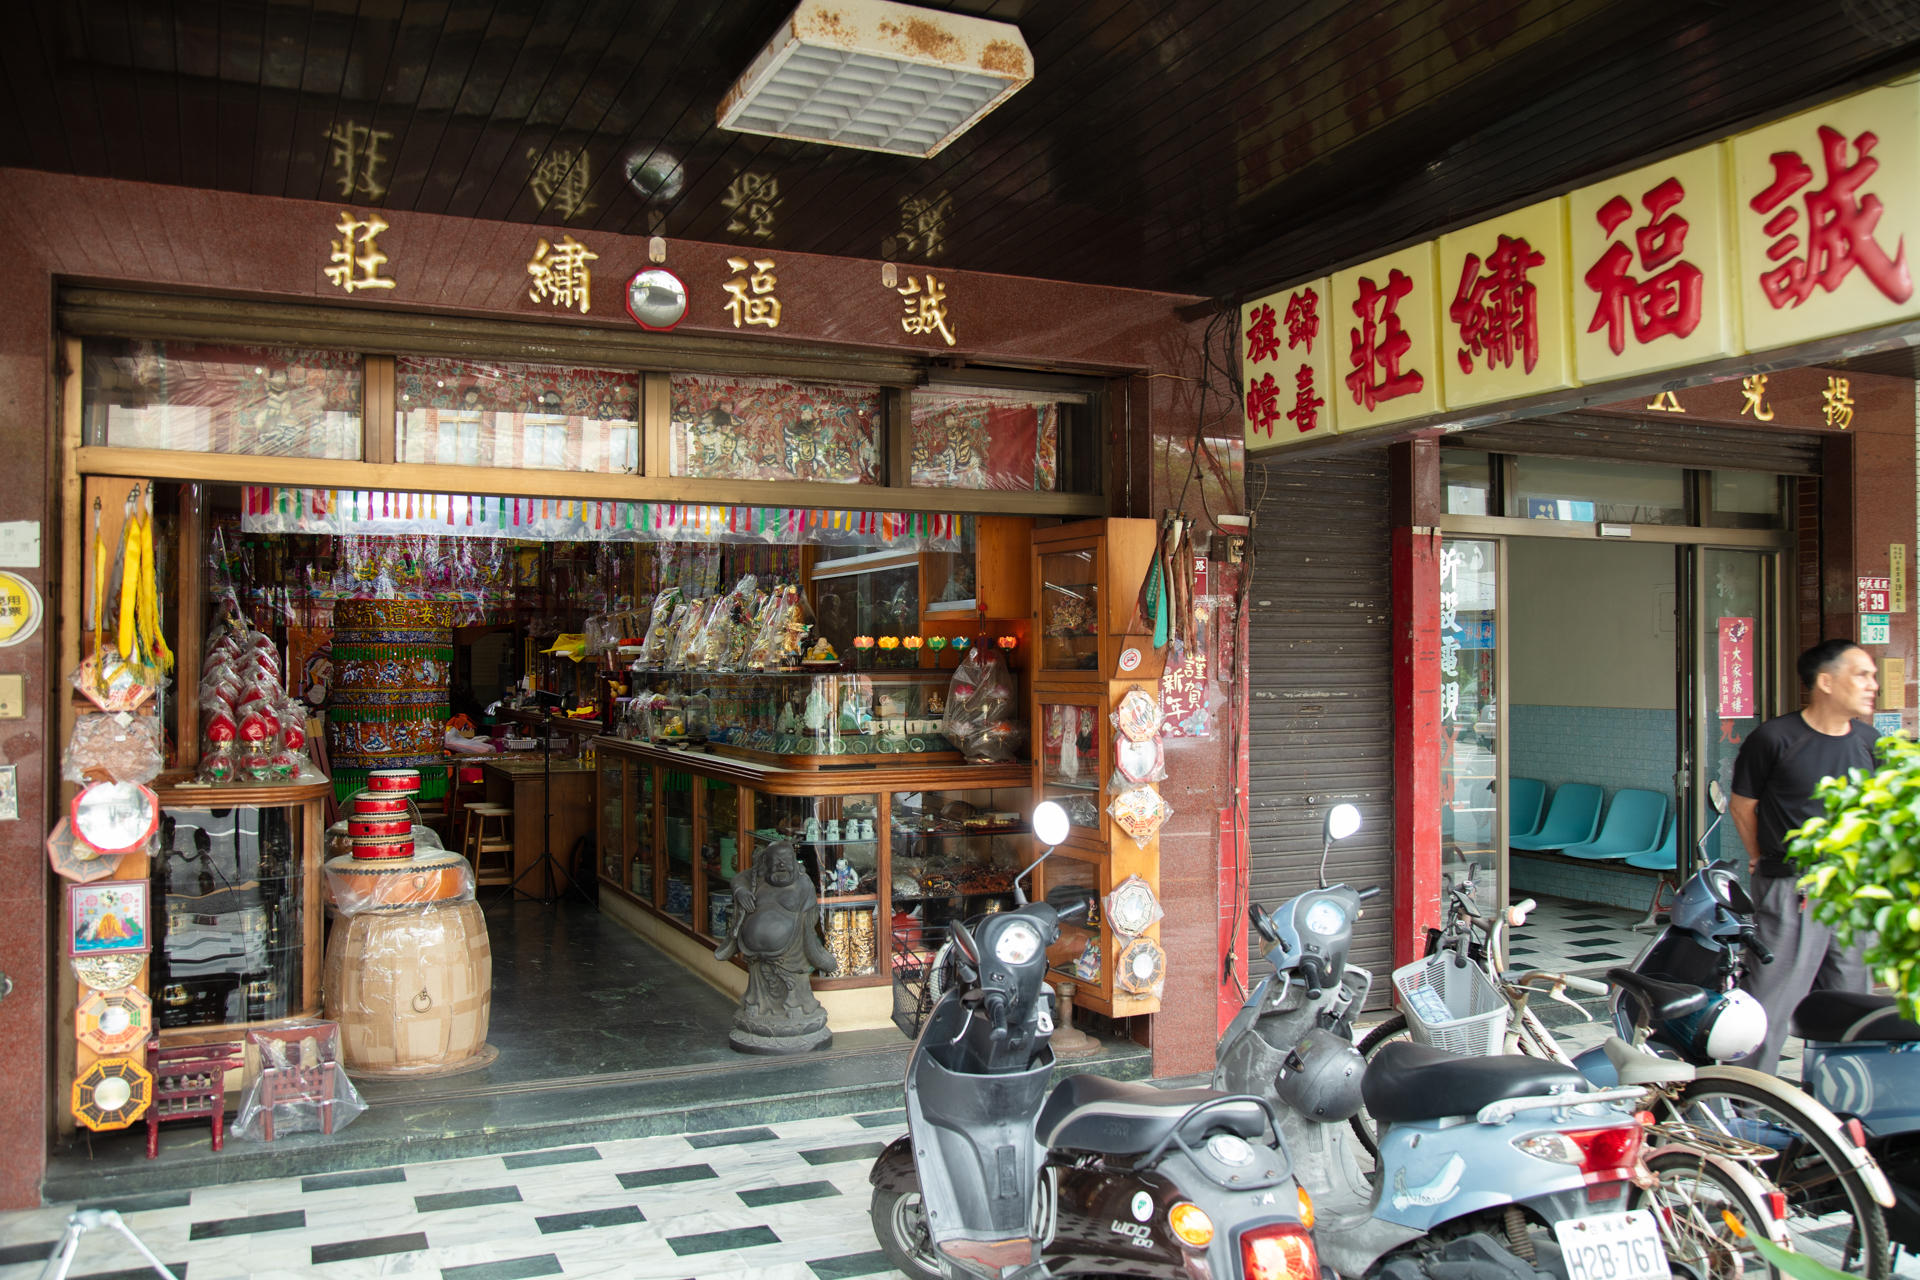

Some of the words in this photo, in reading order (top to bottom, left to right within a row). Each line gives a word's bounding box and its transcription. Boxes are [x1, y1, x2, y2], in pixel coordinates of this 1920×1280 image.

[323, 210, 957, 347] 誠福繡莊
[1345, 124, 1914, 413] 誠福繡莊
[1870, 593, 1885, 610] 39
[1872, 627, 1885, 641] 39
[1162, 667, 1190, 720] 新年
[1132, 1237, 1154, 1249] 100
